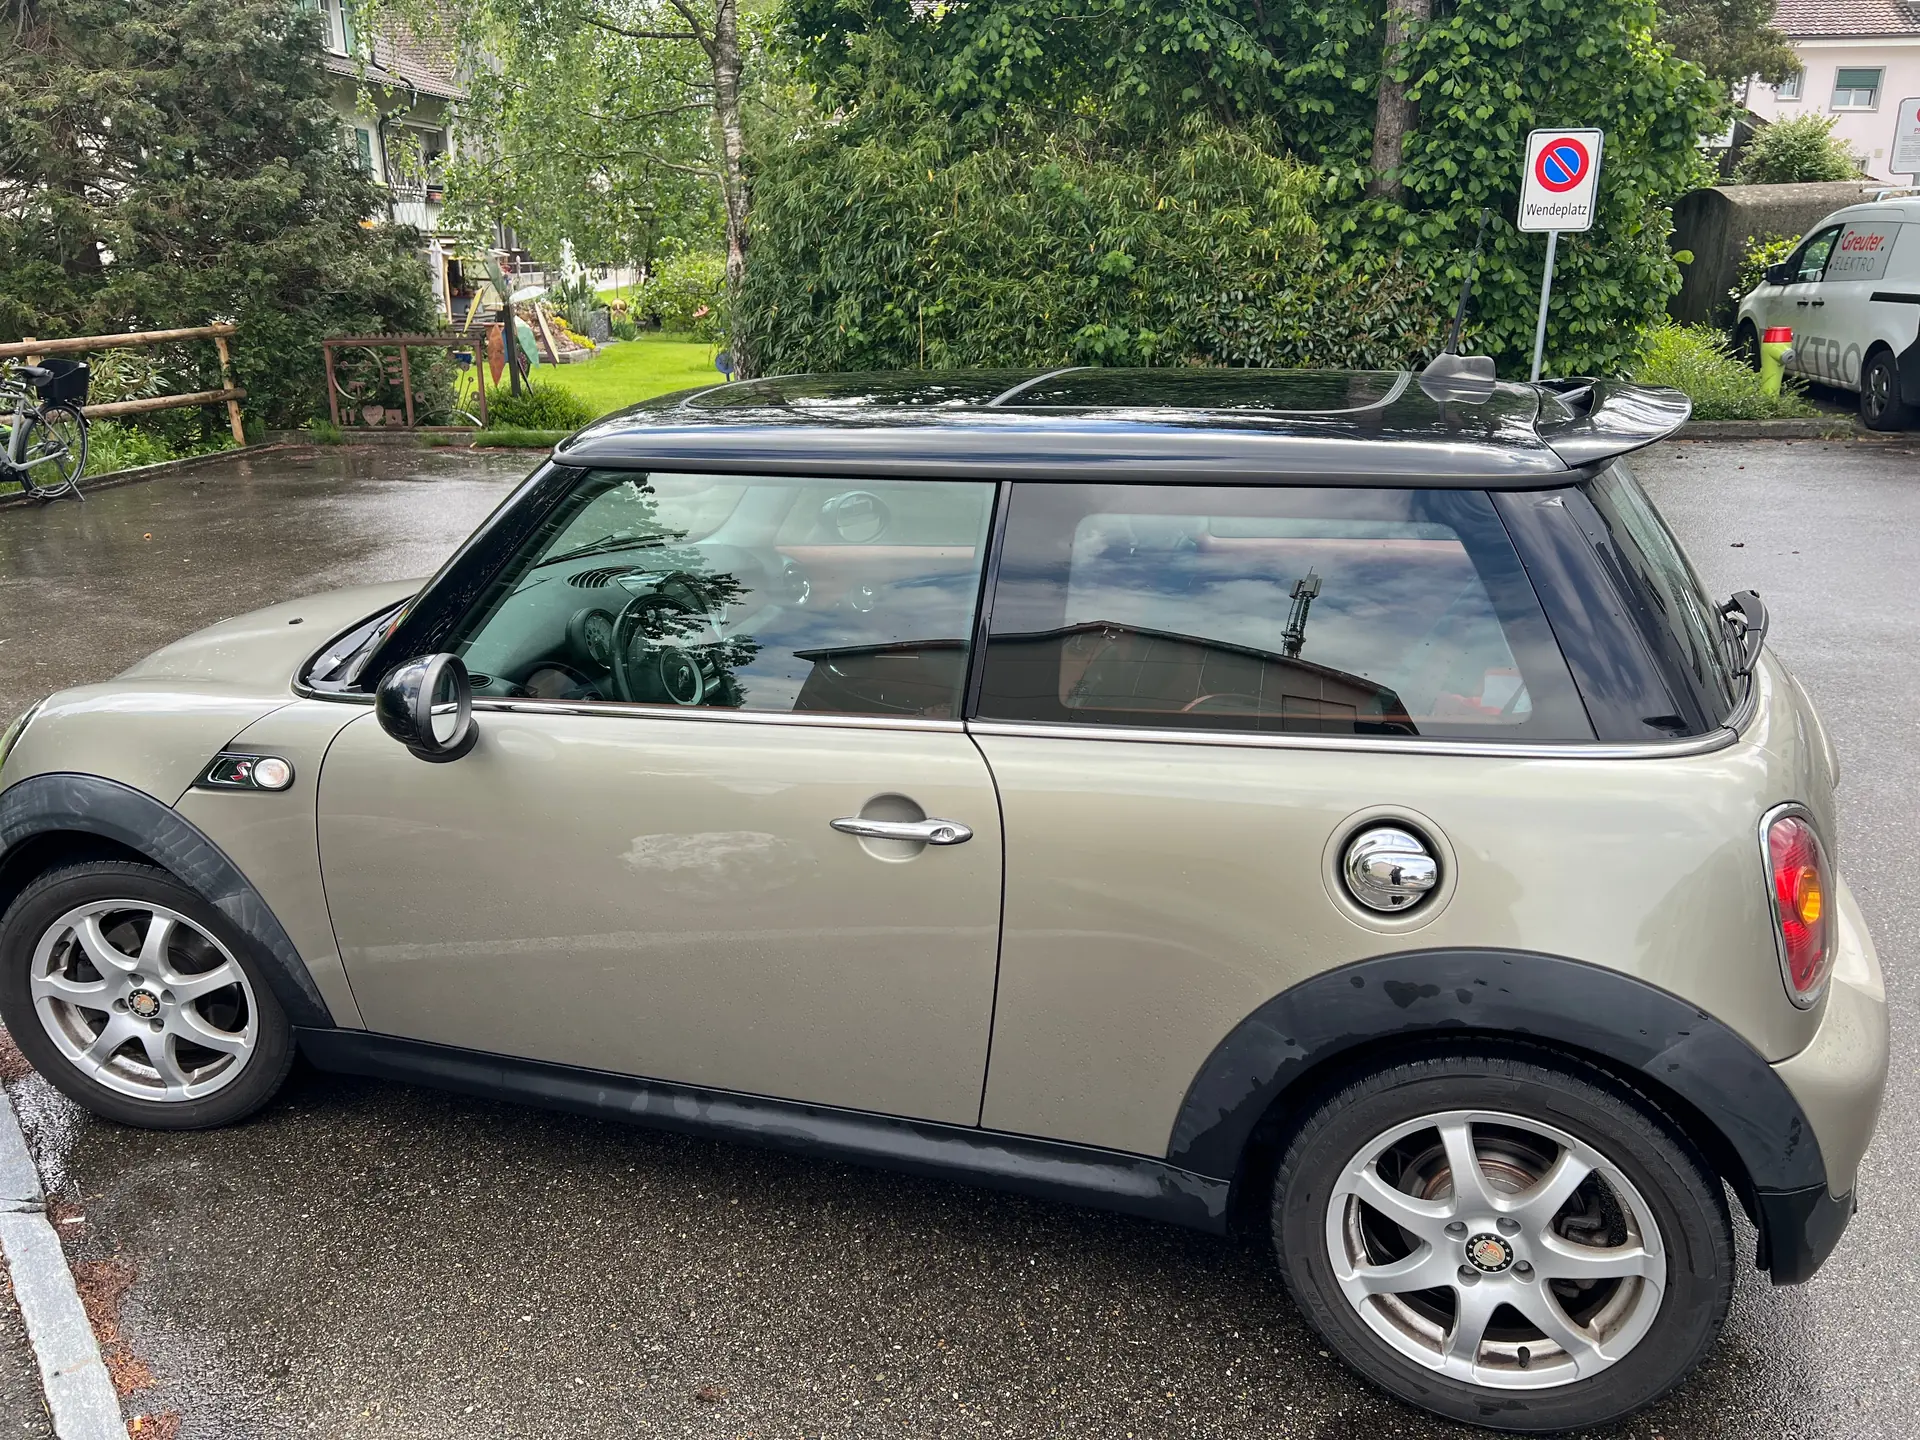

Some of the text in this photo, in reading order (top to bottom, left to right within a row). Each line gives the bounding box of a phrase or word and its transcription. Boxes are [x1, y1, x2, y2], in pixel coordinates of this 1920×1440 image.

[1526, 202, 1588, 219] Wendeplatz
[1833, 256, 1875, 272] ELEKTRO
[1794, 334, 1862, 387] KTRO
